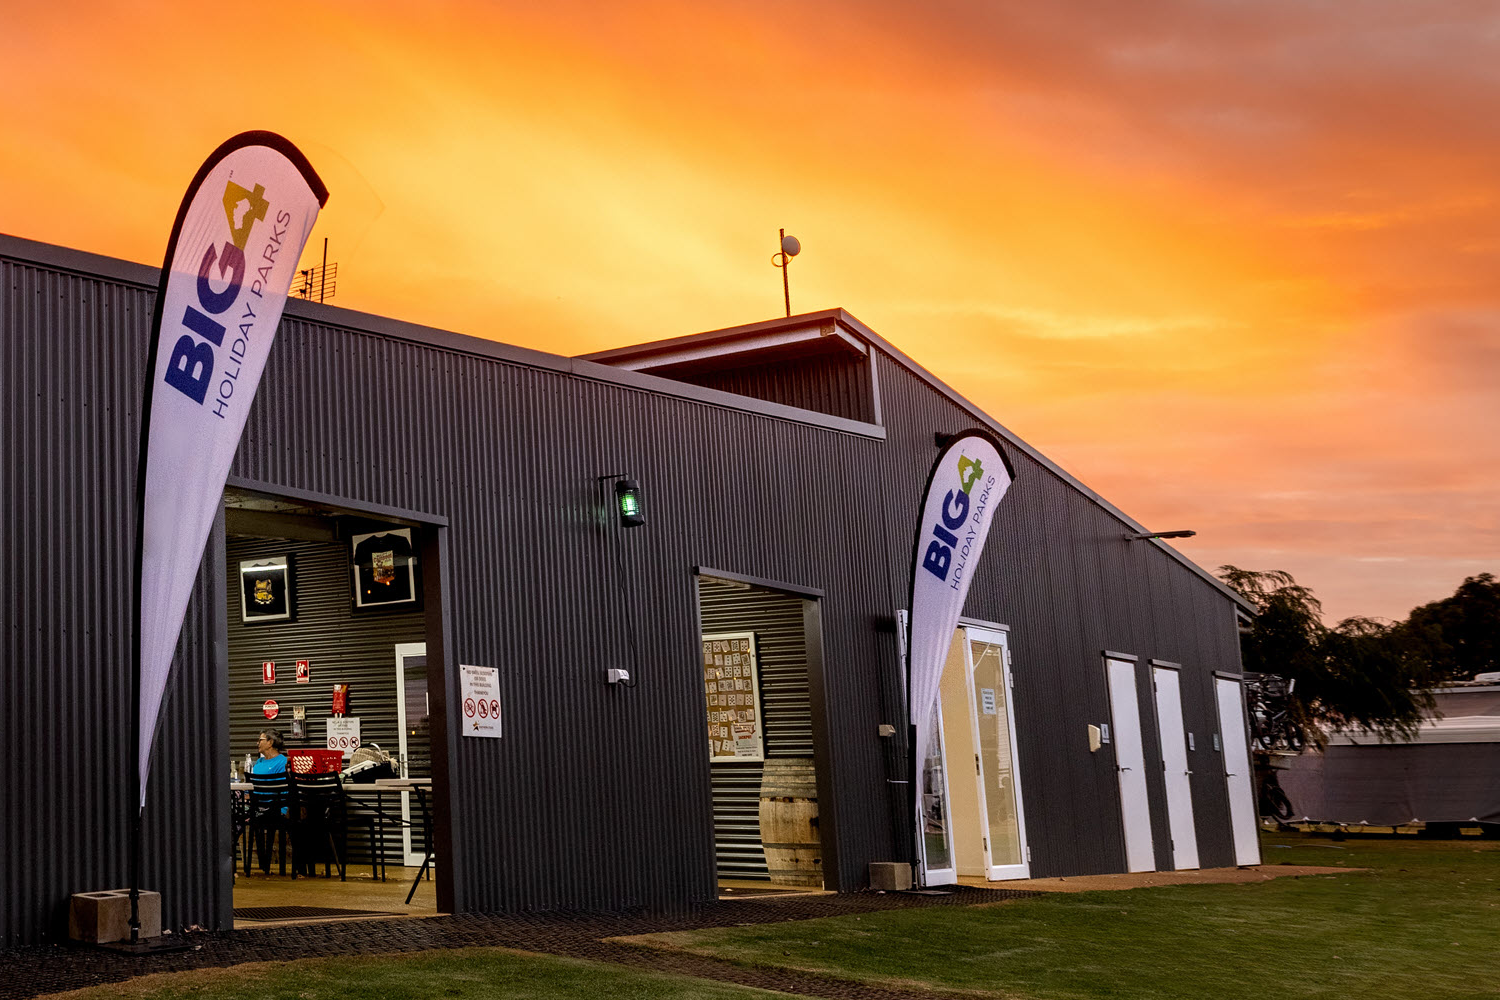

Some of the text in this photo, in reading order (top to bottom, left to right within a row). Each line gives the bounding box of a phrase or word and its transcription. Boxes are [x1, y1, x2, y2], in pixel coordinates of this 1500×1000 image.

[164, 180, 270, 406] BIG4
[212, 209, 291, 419] HOLIDAY PARKS
[922, 454, 985, 582] BIG4
[950, 475, 996, 591] HOLIDAY PARKS
